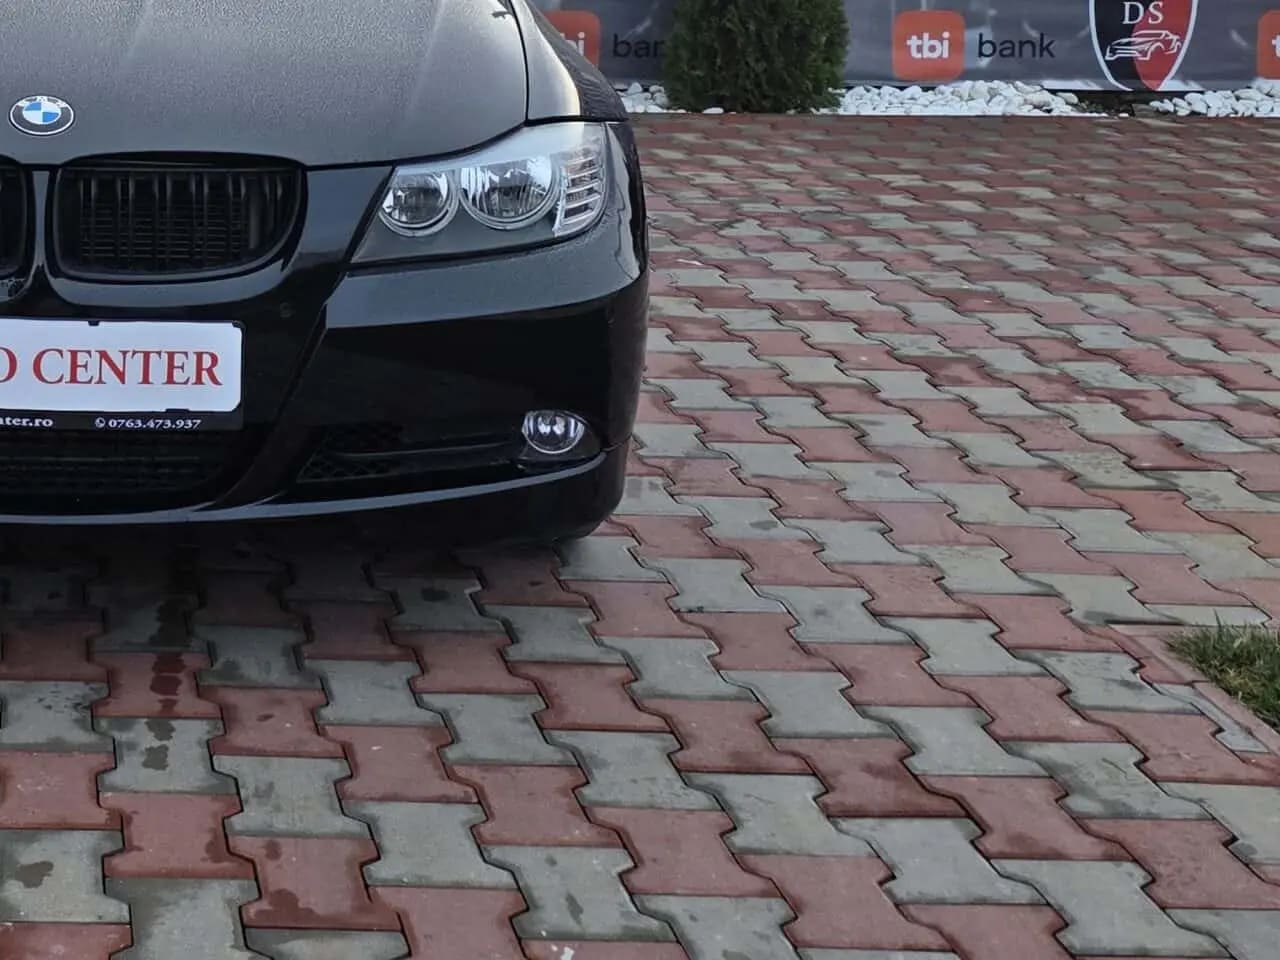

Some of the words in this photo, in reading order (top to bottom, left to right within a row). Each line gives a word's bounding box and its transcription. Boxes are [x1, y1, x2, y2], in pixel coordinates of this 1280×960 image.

[1122, 1, 1164, 25] DS
[907, 31, 950, 60] tbi
[977, 33, 1056, 60] bank
[32, 348, 224, 387] CENTER
[108, 418, 202, 429] 0763.473.937
